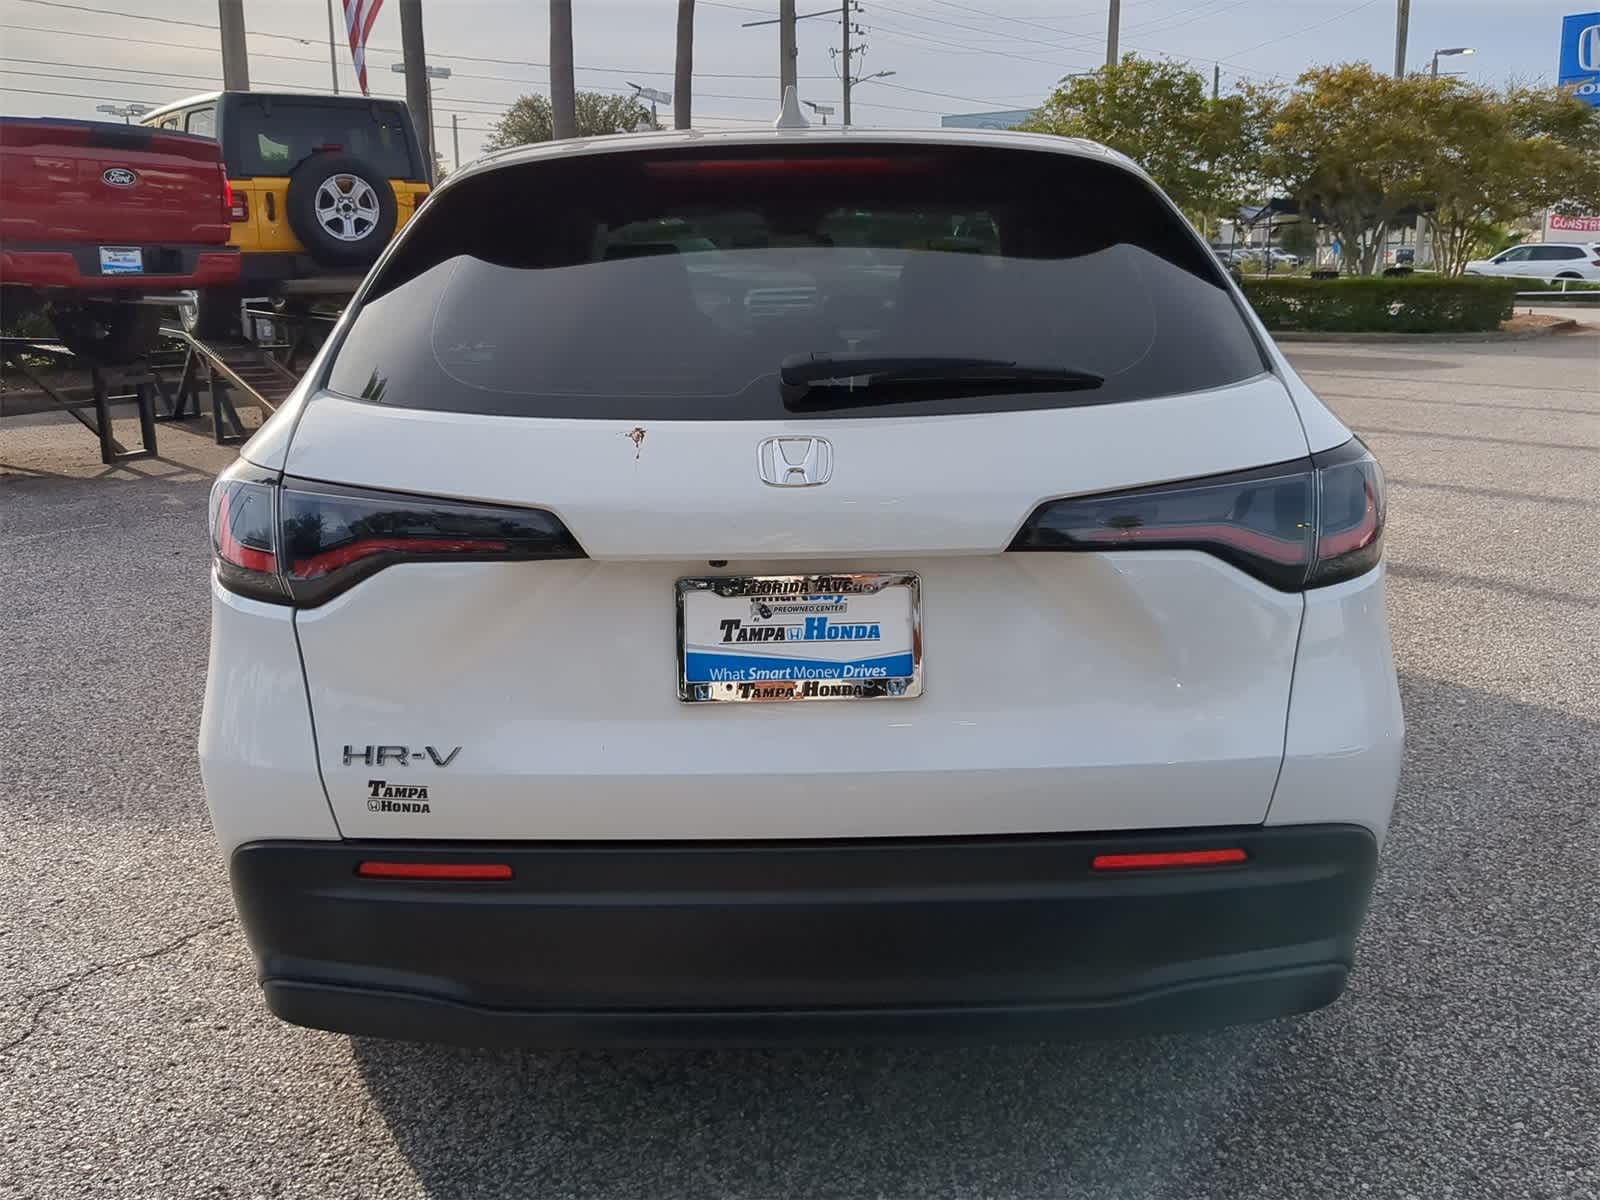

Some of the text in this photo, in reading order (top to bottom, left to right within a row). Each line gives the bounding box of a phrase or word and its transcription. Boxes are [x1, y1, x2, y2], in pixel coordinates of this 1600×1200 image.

[109, 170, 130, 183] Ford
[1553, 217, 1600, 230] CONSTR
[816, 604, 844, 613] CENTER
[710, 665, 887, 681] What Smart Money Drives
[343, 745, 462, 767] HR-V
